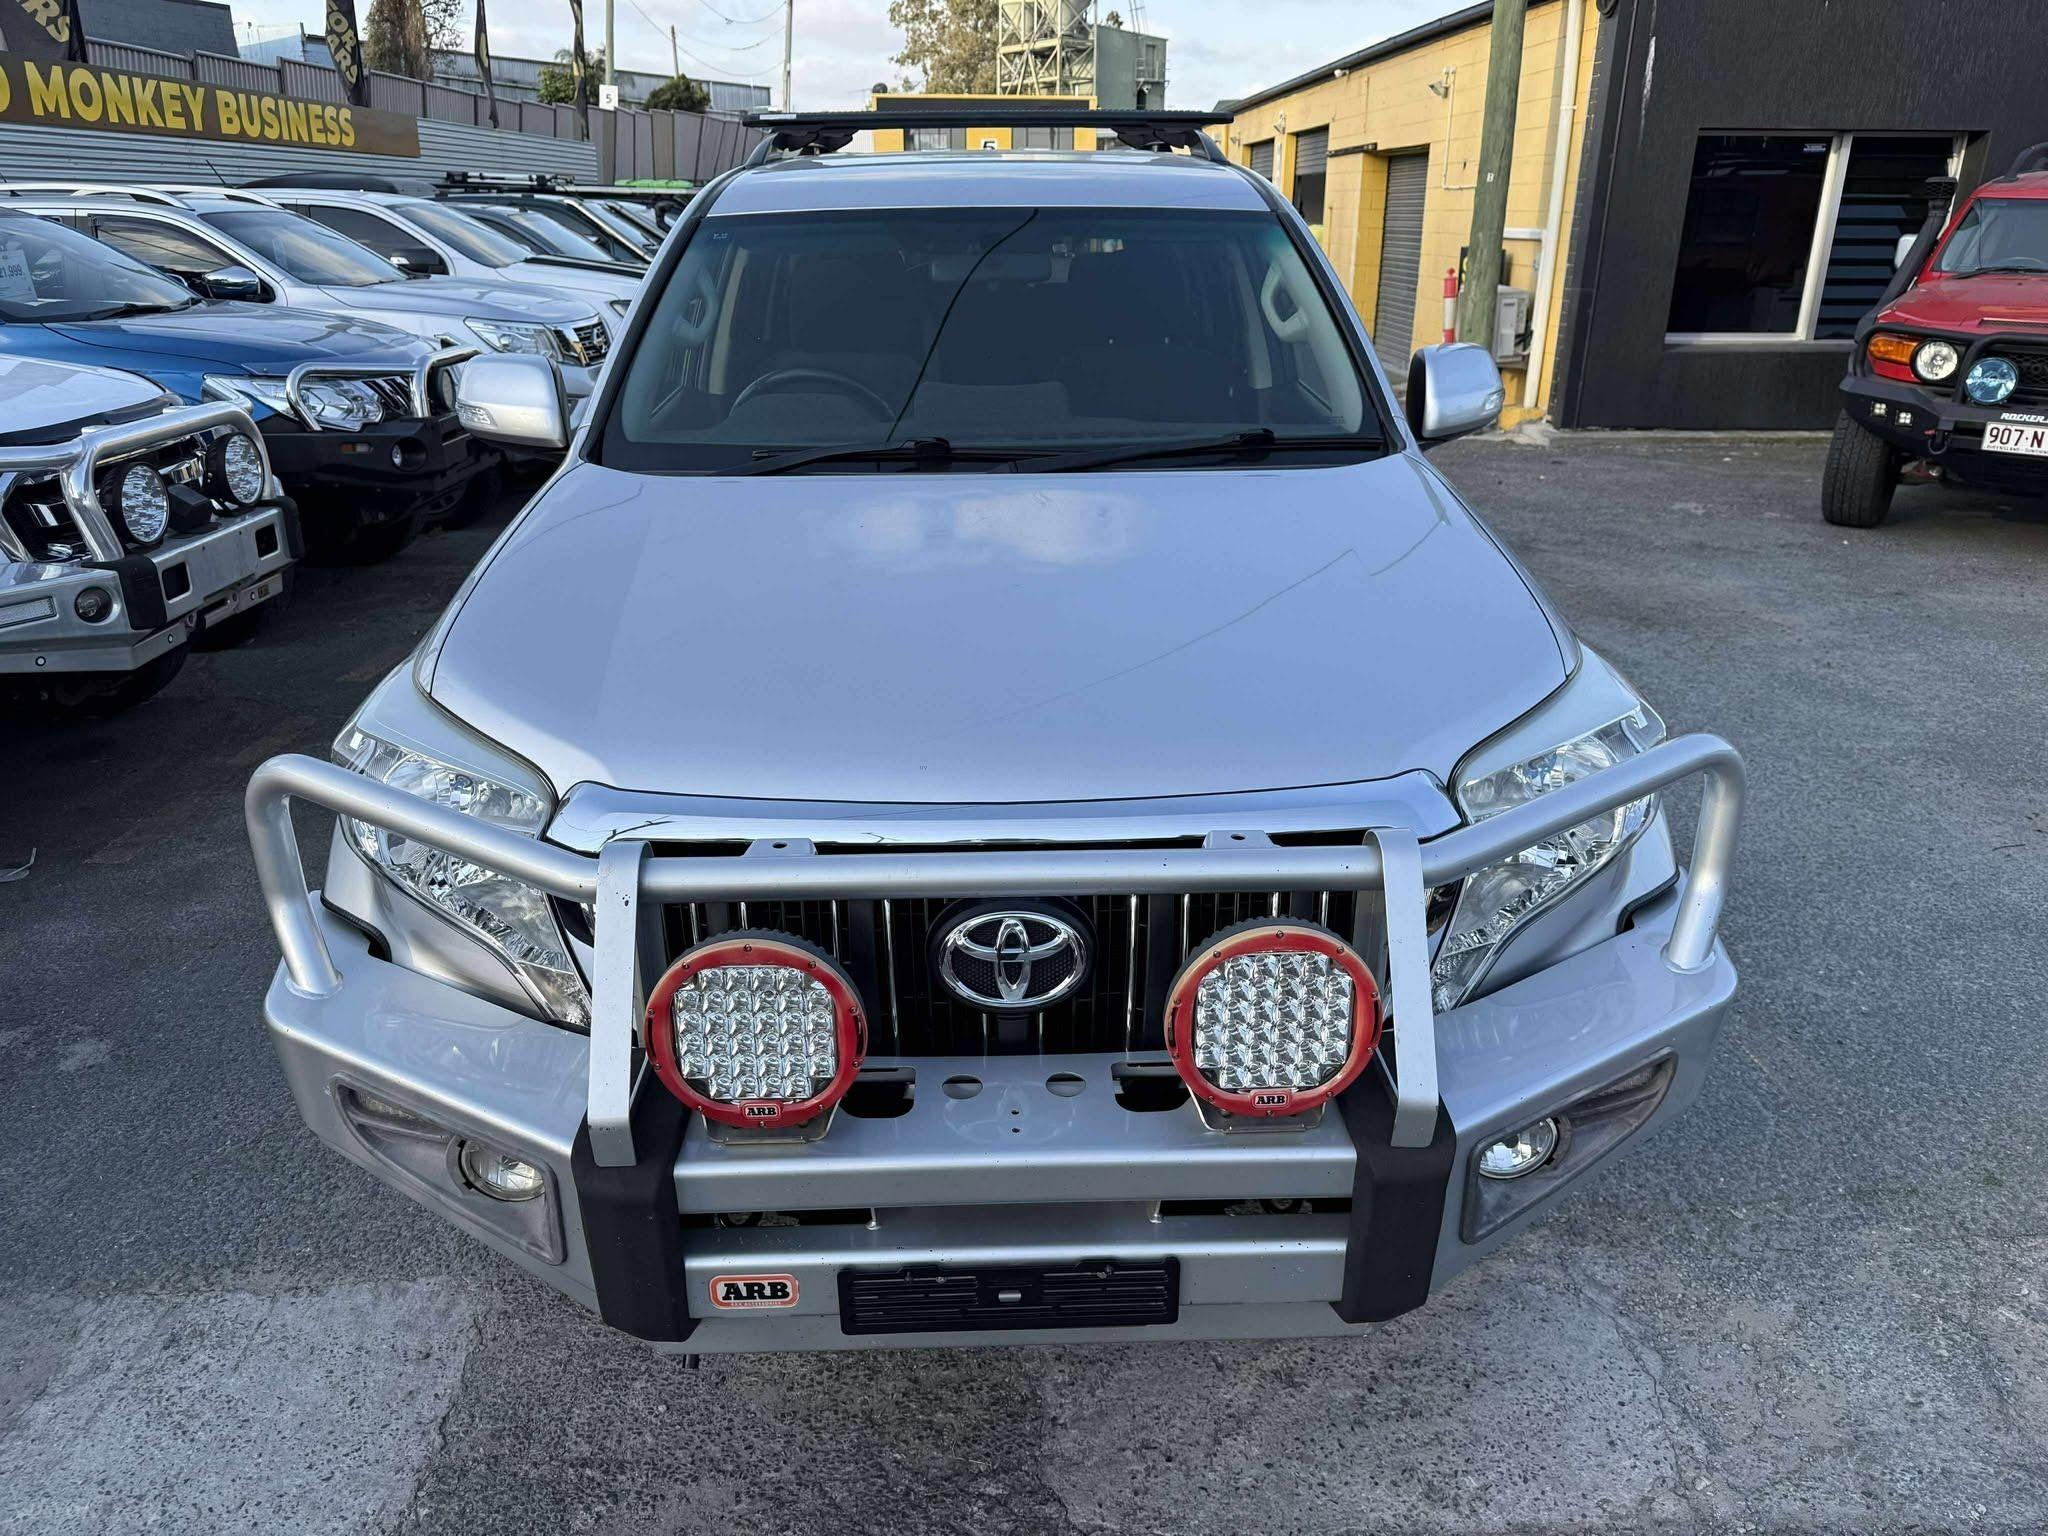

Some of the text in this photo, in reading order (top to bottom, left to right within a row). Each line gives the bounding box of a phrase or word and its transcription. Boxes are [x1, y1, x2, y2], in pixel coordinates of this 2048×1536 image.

[16, 0, 70, 43] RS
[24, 61, 205, 132] MONKEY
[215, 89, 356, 147] BUSINESS
[606, 93, 613, 104] 5
[1256, 1095, 1286, 1105] ARB
[747, 1107, 777, 1116] ARB
[721, 1281, 790, 1301] ARB
